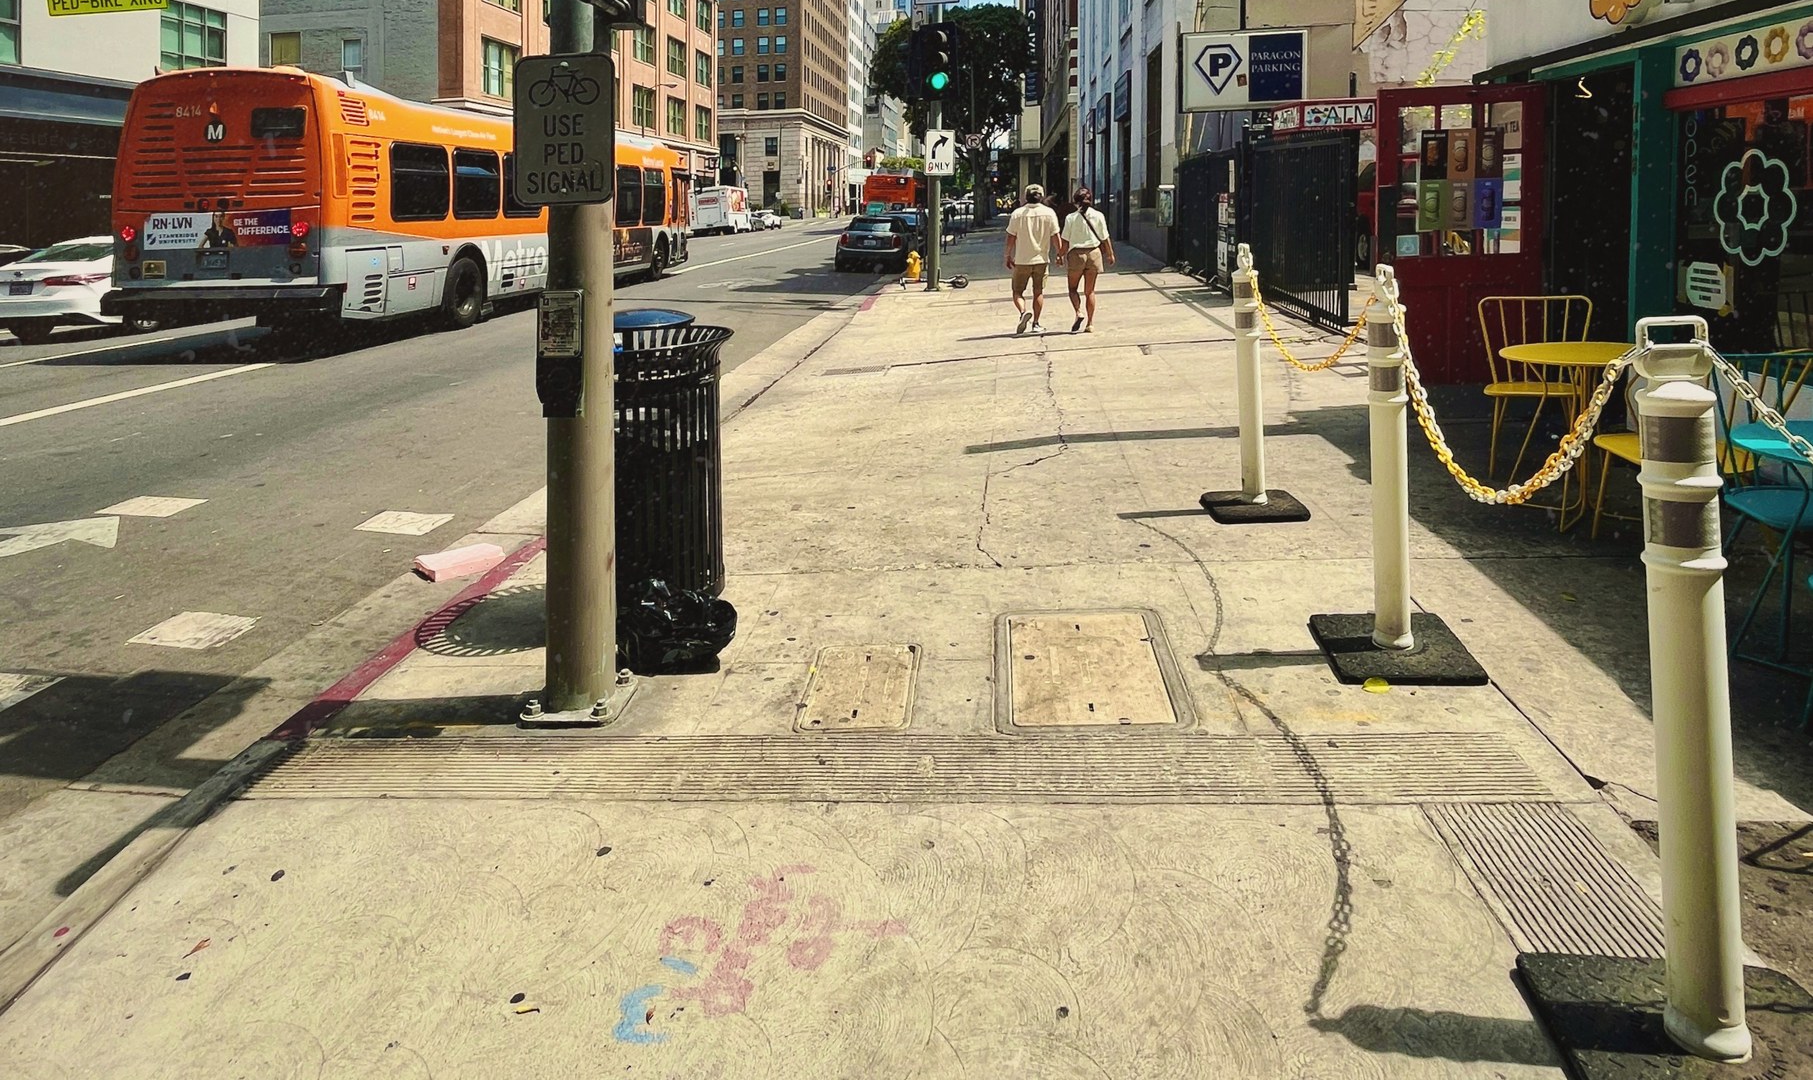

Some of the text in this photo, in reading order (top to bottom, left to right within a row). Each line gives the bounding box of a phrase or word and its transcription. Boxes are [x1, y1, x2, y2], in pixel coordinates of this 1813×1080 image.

[1251, 50, 1301, 61] PARAGON
[1209, 53, 1232, 77] P
[1251, 62, 1301, 73] PARKING
[175, 105, 202, 119] 8414
[1326, 104, 1374, 124] ATM
[207, 124, 223, 140] M
[543, 114, 584, 137] USE
[544, 142, 584, 166] PED
[927, 161, 951, 171] ONLY
[526, 170, 602, 195] SIGNAL
[245, 217, 259, 226] THE
[481, 239, 547, 282] Metro
